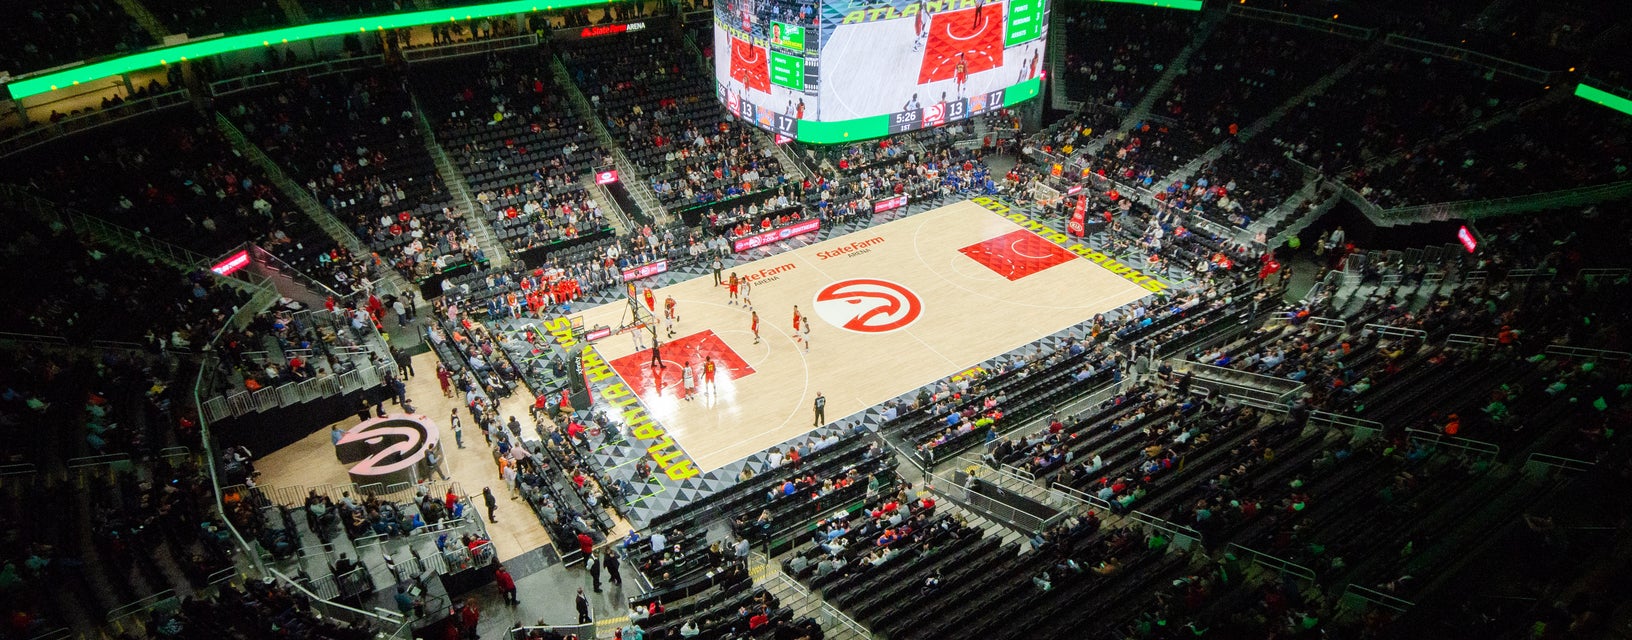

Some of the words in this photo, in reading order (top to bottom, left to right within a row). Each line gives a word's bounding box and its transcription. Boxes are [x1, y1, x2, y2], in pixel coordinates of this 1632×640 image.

[626, 22, 646, 32] ARENA
[990, 91, 1003, 107] 17
[742, 101, 753, 118] 13
[949, 101, 963, 117] 13
[778, 116, 793, 132] 17
[896, 111, 916, 124] 5:26
[901, 123, 911, 132] 1ST
[972, 196, 1070, 244] ATLANTA
[1068, 243, 1169, 292] HAWKS
[846, 248, 872, 259] ARENA
[600, 383, 700, 480] ATLANTA
